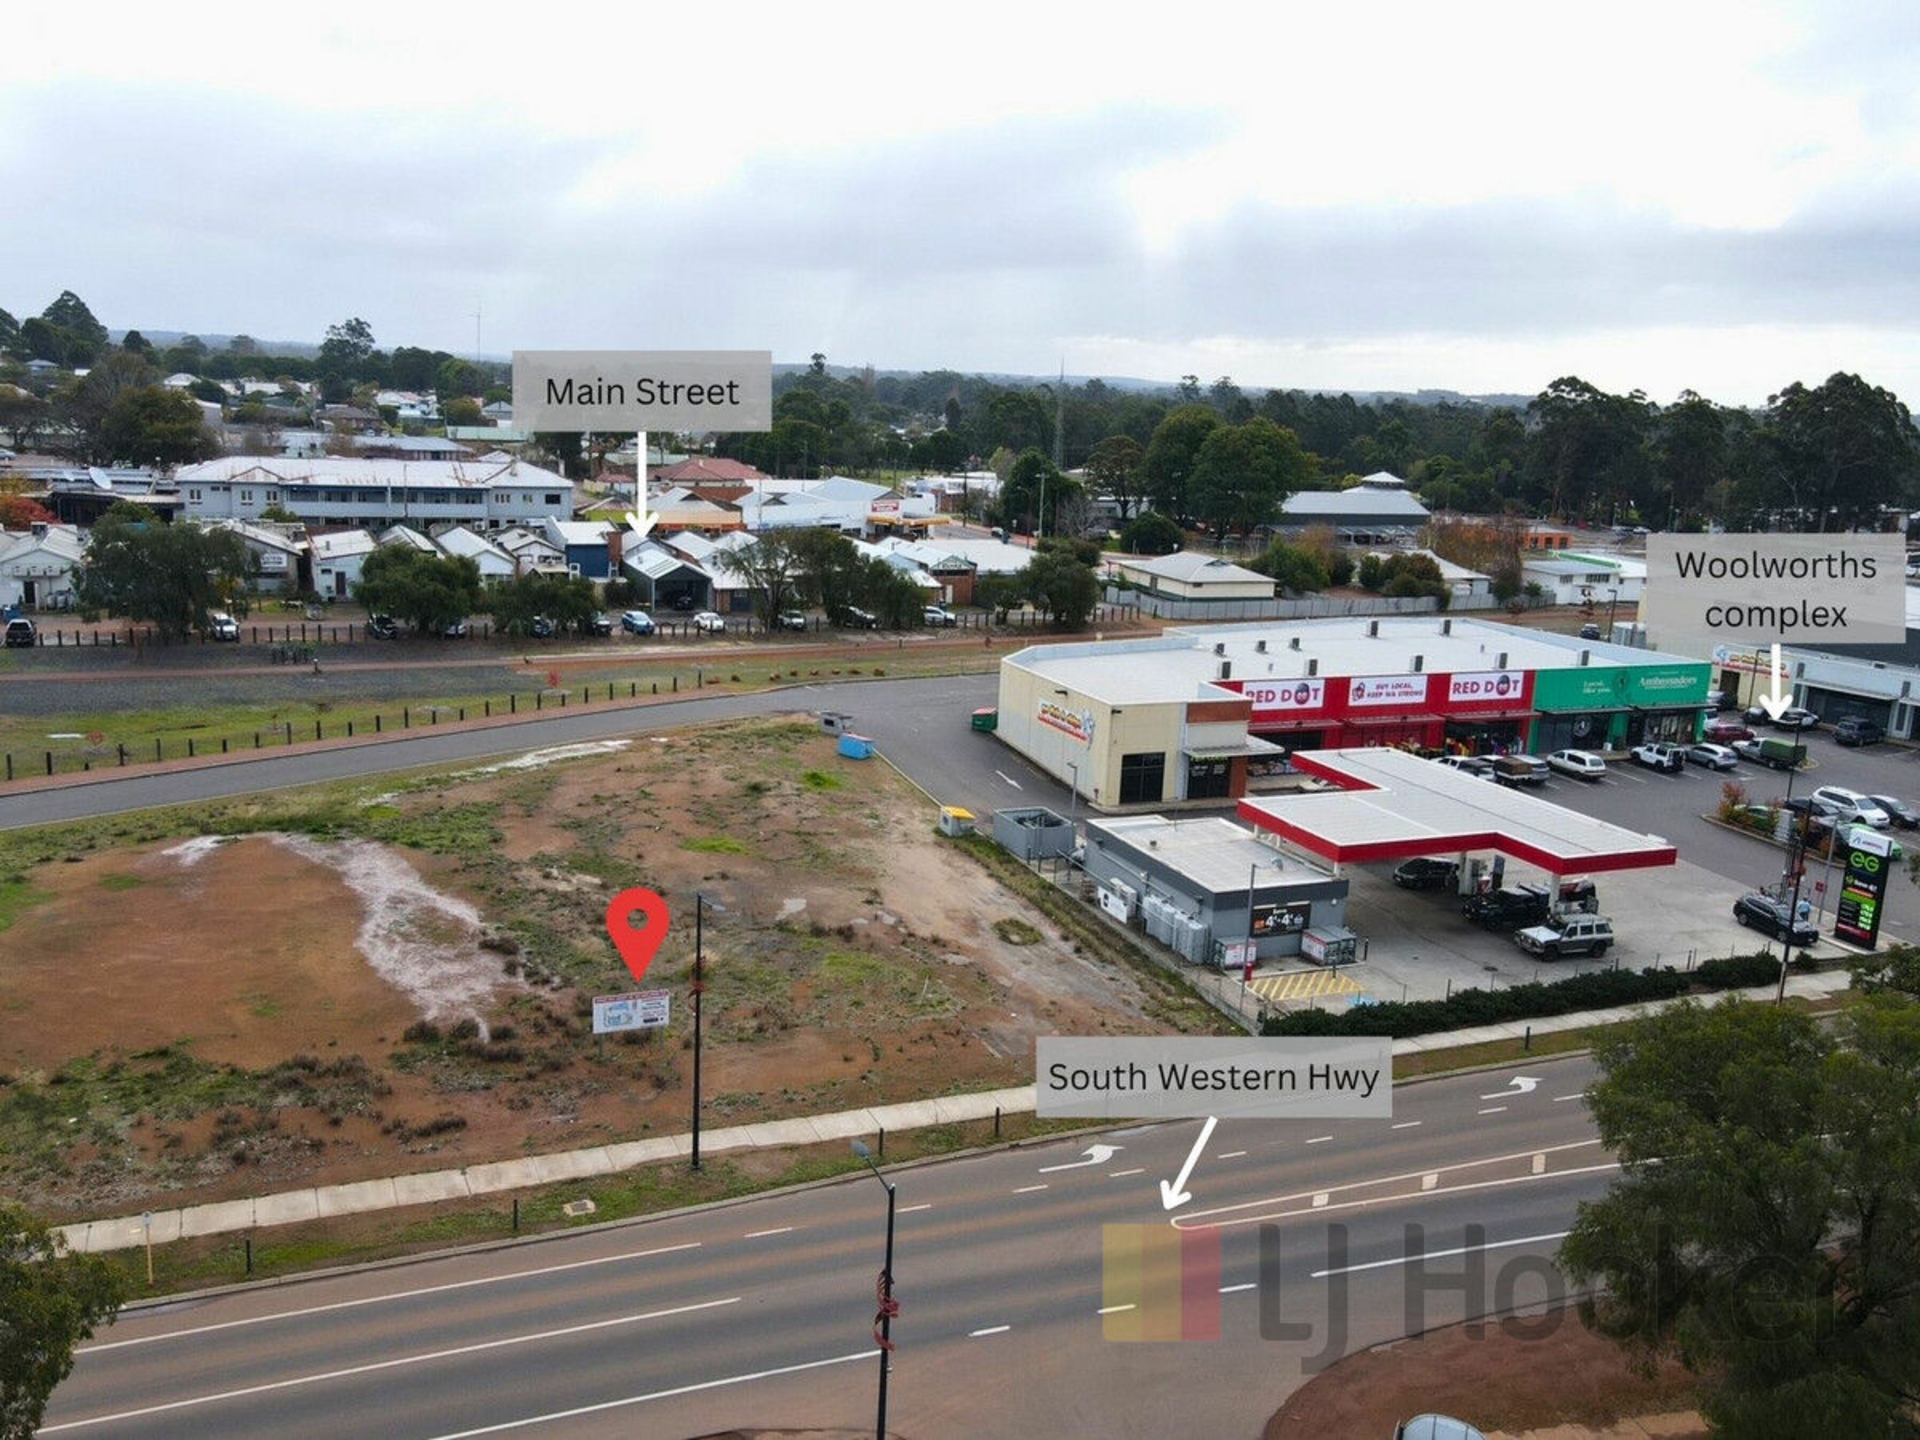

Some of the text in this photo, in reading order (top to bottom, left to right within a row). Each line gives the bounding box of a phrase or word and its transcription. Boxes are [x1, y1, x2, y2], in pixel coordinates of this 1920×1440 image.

[1281, 682, 1320, 705] DOT
[1452, 674, 1520, 696] RED DOT
